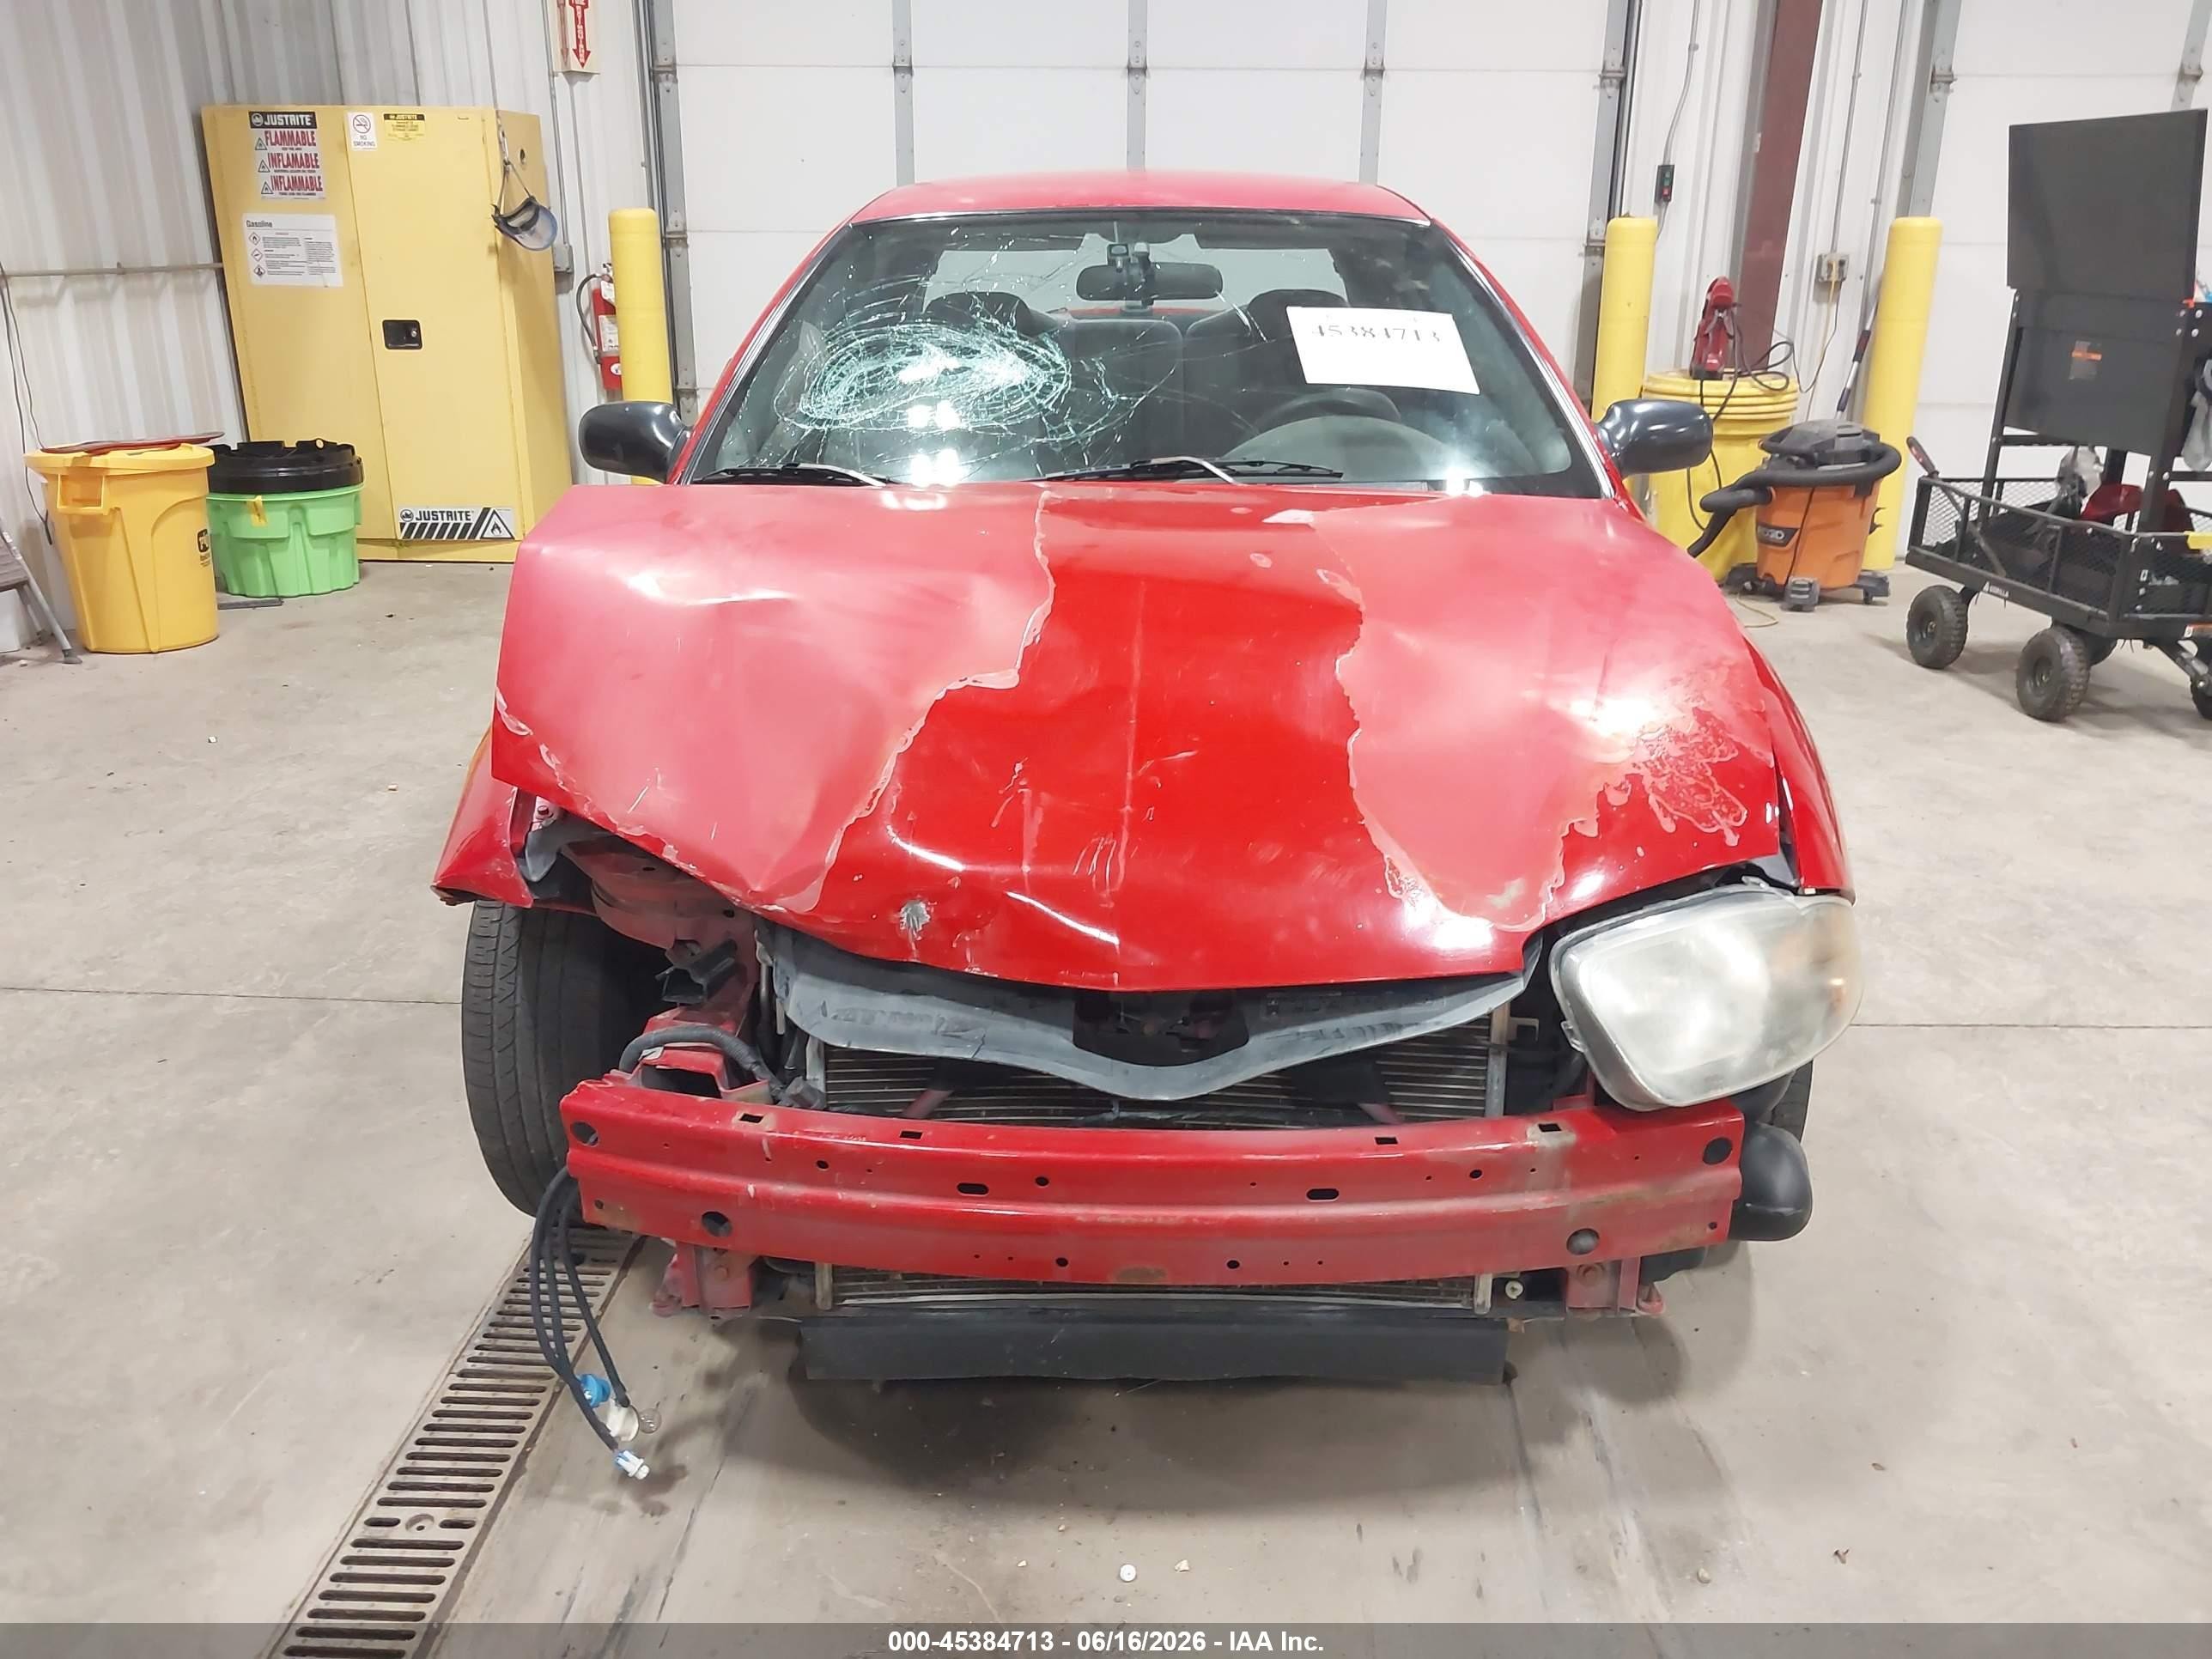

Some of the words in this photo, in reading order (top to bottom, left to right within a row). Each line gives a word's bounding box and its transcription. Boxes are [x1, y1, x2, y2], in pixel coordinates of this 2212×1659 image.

[264, 114, 312, 126] JUSTRITE
[264, 130, 316, 147] FLAMMABLE
[267, 152, 320, 169] INFLAMABLE
[270, 175, 324, 192] INFLAMMABLE
[246, 220, 273, 228] Gasoline
[416, 510, 471, 521] JUSTRITE
